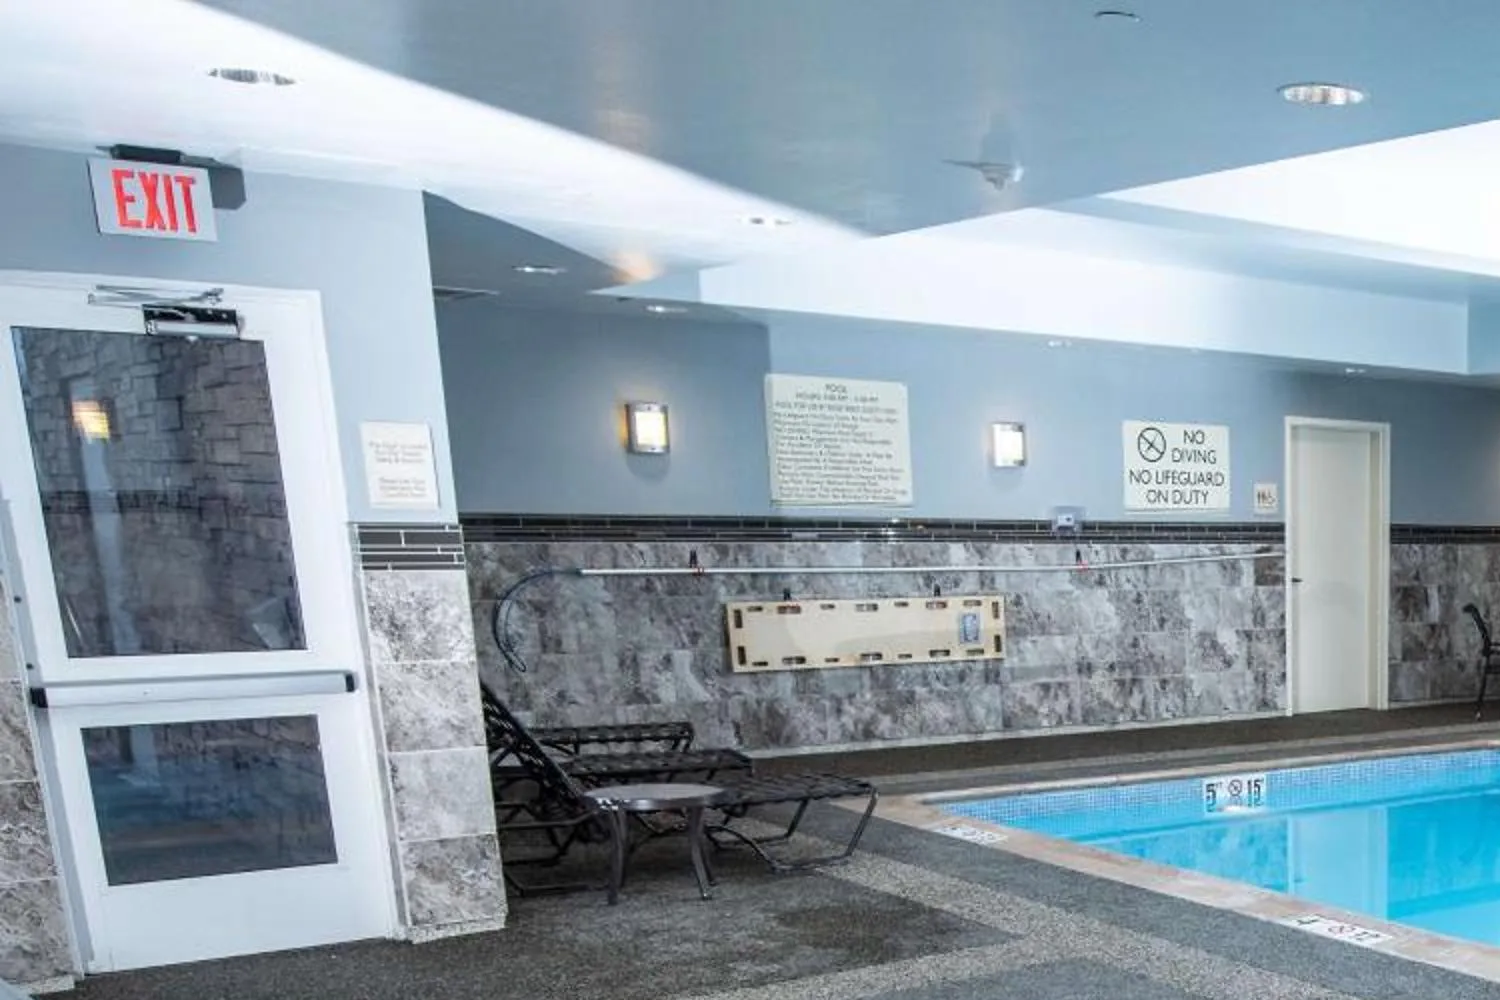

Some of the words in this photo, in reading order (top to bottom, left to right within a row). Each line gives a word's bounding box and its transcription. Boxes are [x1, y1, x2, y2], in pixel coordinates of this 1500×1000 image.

[111, 167, 198, 234] EXIT
[1183, 429, 1205, 445] NO
[1171, 447, 1217, 465] DIVING
[1129, 469, 1152, 485] NO
[1155, 469, 1225, 487] LIFEGUARD
[1146, 489, 1170, 504] ON
[1172, 489, 1209, 505] DUTY
[1205, 783, 1217, 800] 5
